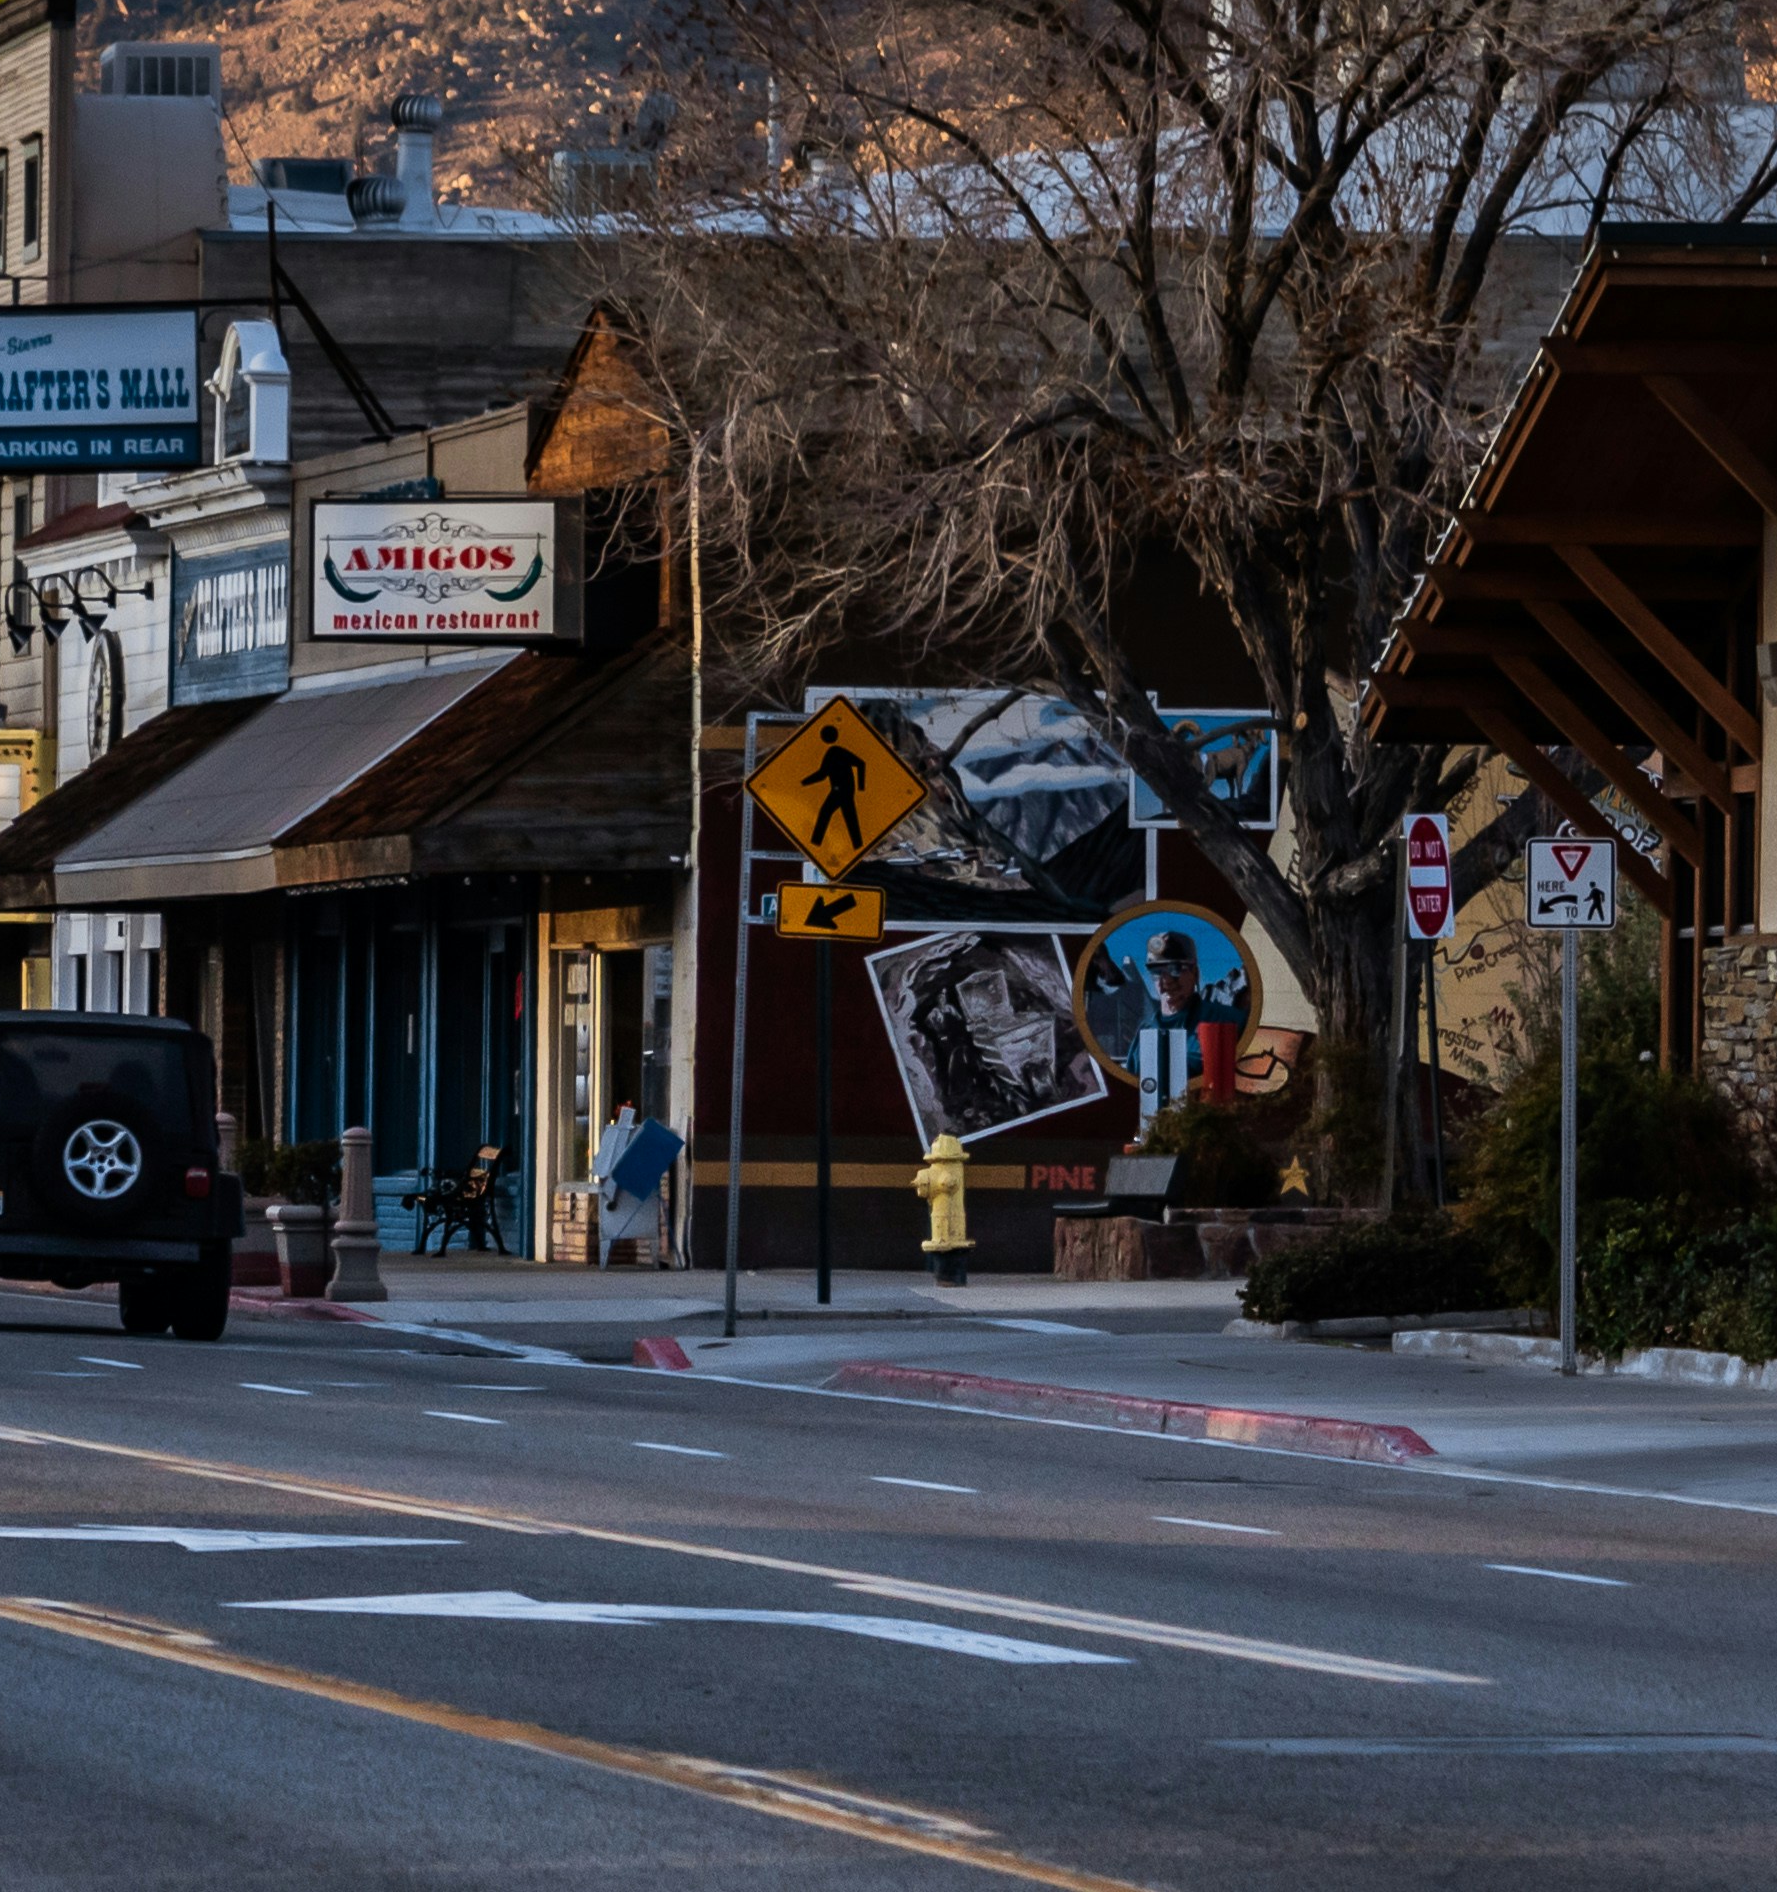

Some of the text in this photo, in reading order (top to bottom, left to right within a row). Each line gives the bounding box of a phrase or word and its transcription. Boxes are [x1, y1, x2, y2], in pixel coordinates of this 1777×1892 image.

[119, 367, 190, 409] MALL
[90, 439, 112, 456] IN
[123, 437, 185, 455] REAR
[344, 545, 517, 572] AMIGOS
[332, 608, 540, 631] mexican restaurant
[1409, 840, 1442, 859] DO NOT
[1536, 880, 1566, 893] HERE
[1416, 894, 1442, 914] ENTER
[1564, 906, 1579, 919] TO
[1031, 1165, 1096, 1191] PINE
